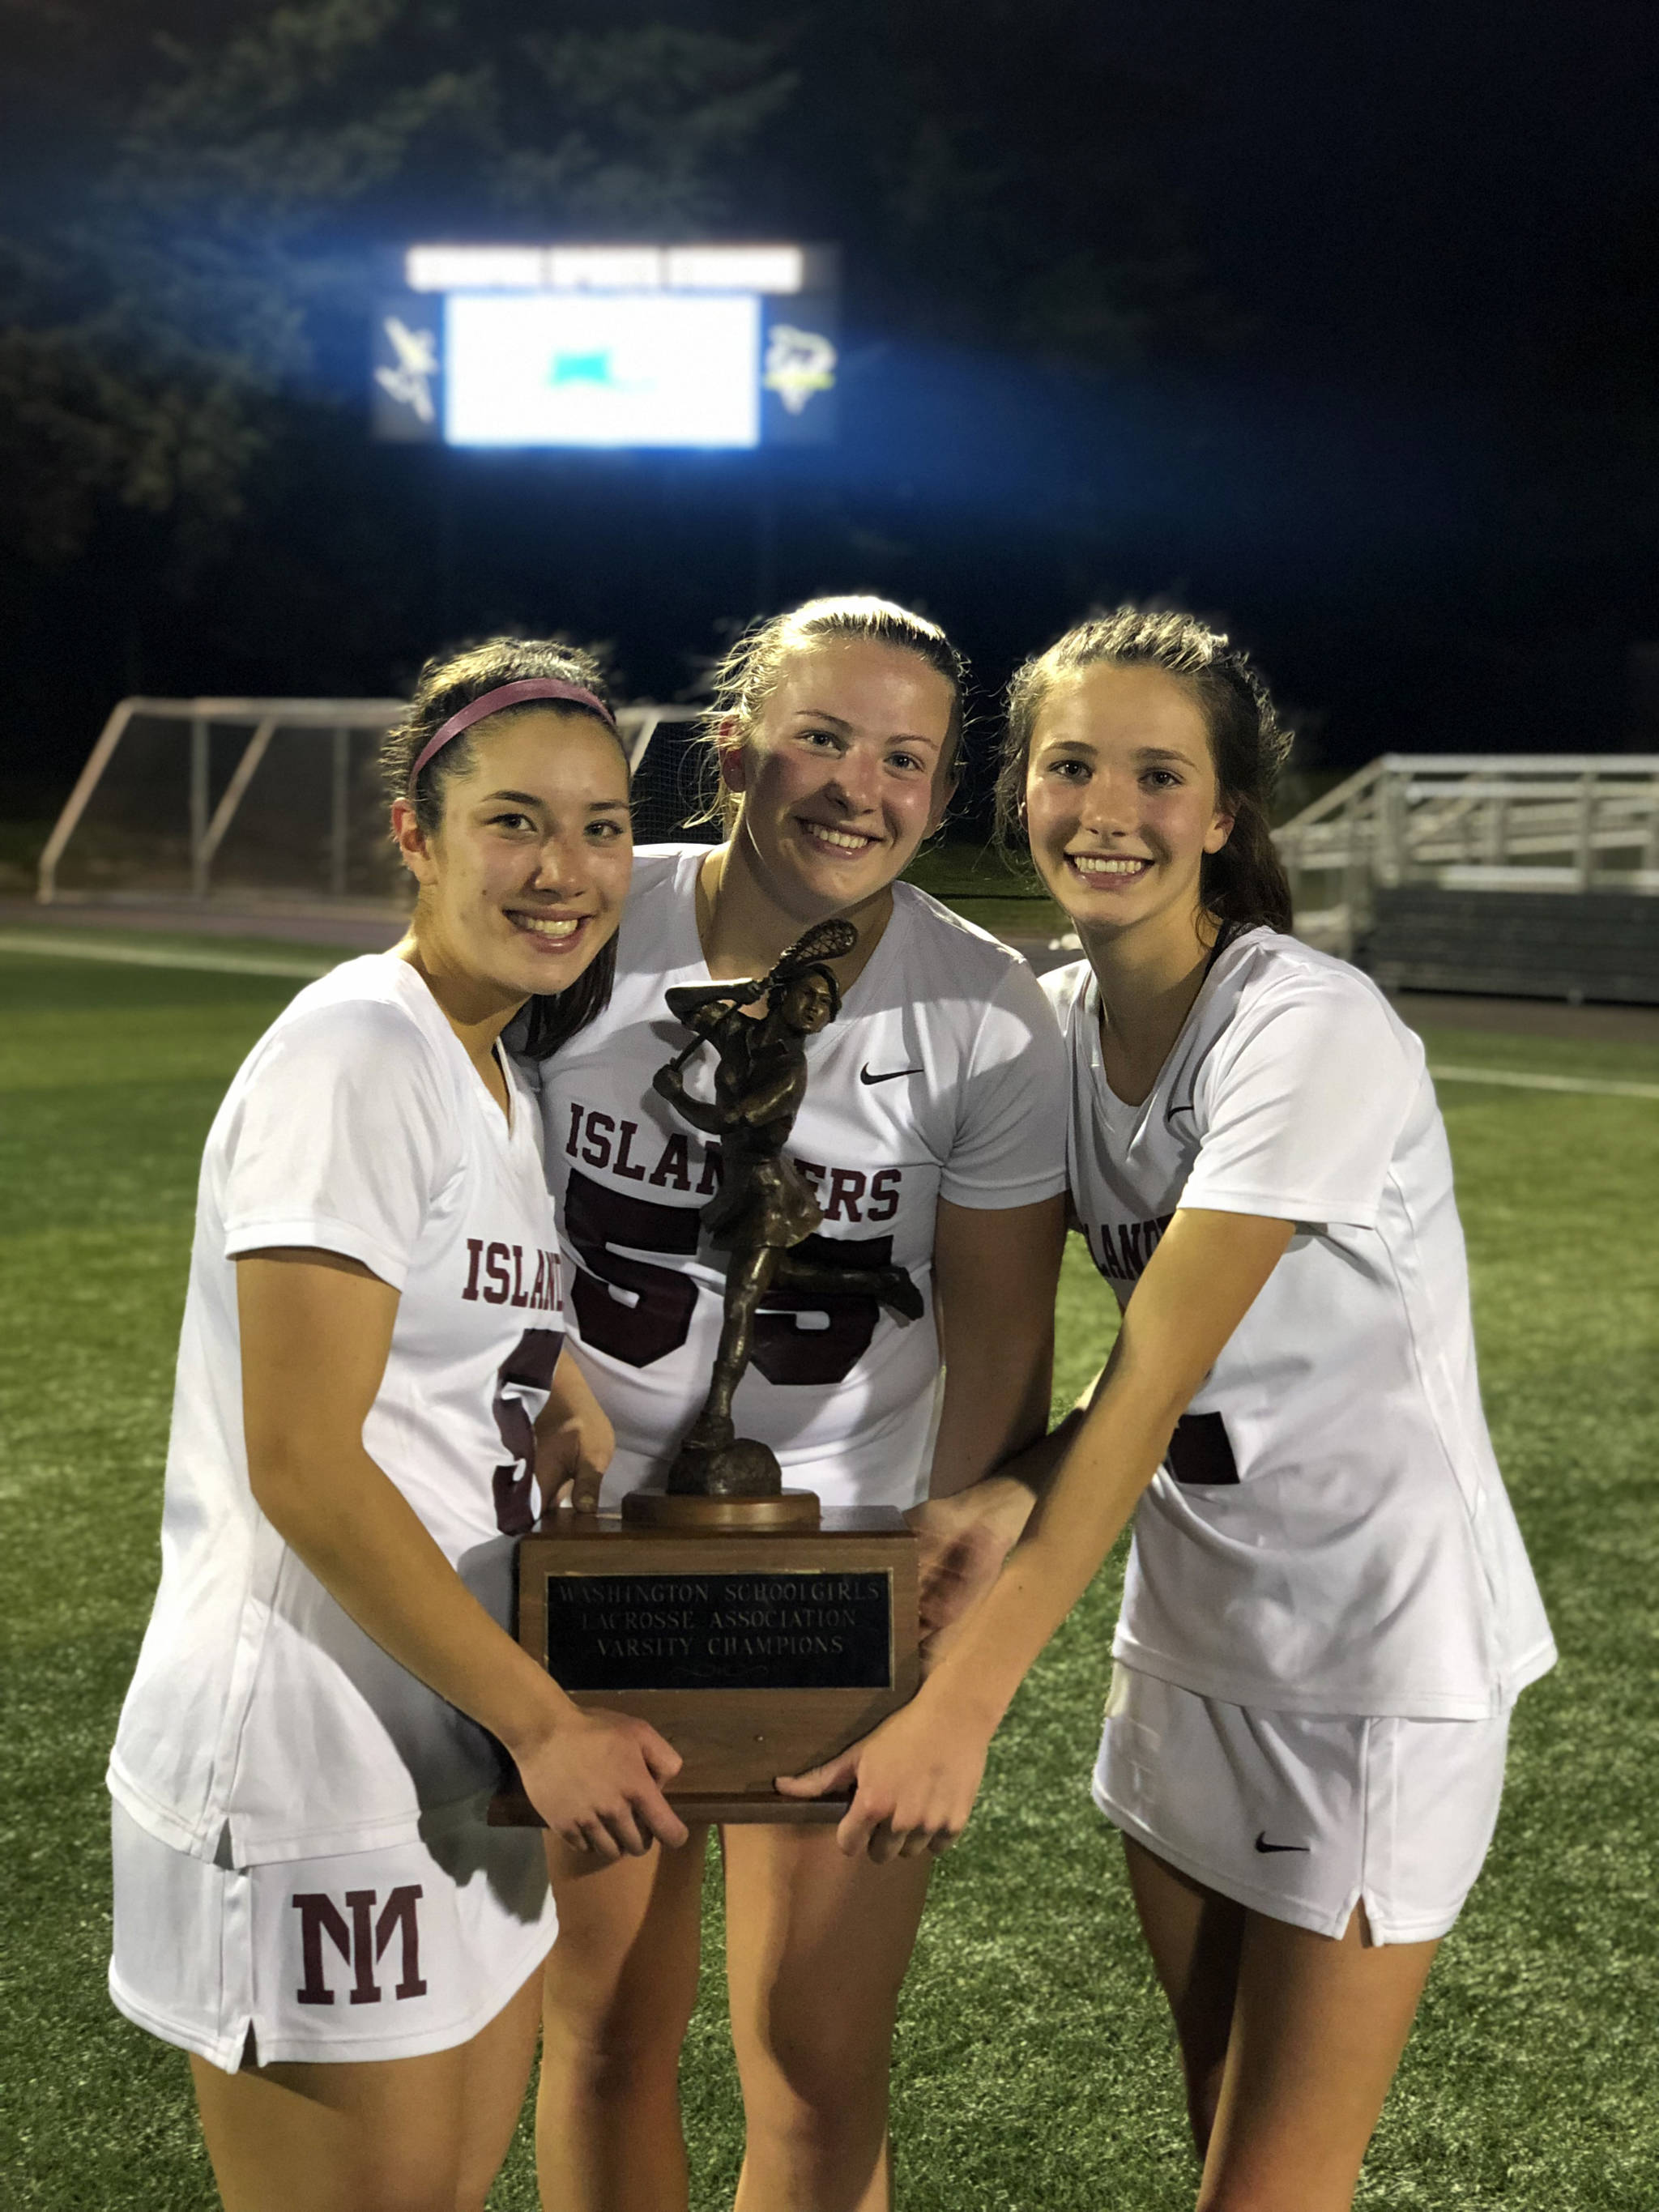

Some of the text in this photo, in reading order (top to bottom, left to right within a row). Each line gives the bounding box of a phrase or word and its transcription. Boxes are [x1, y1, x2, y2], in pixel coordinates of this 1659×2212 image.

[565, 1102, 902, 1223] ISLANERS
[558, 1580, 881, 1604] WASHINGTON SCHOOLGIRLS
[582, 1608, 856, 1630] LACROSSE ASSOCIATION
[596, 1634, 843, 1657] VARSITY CHAMPIONS
